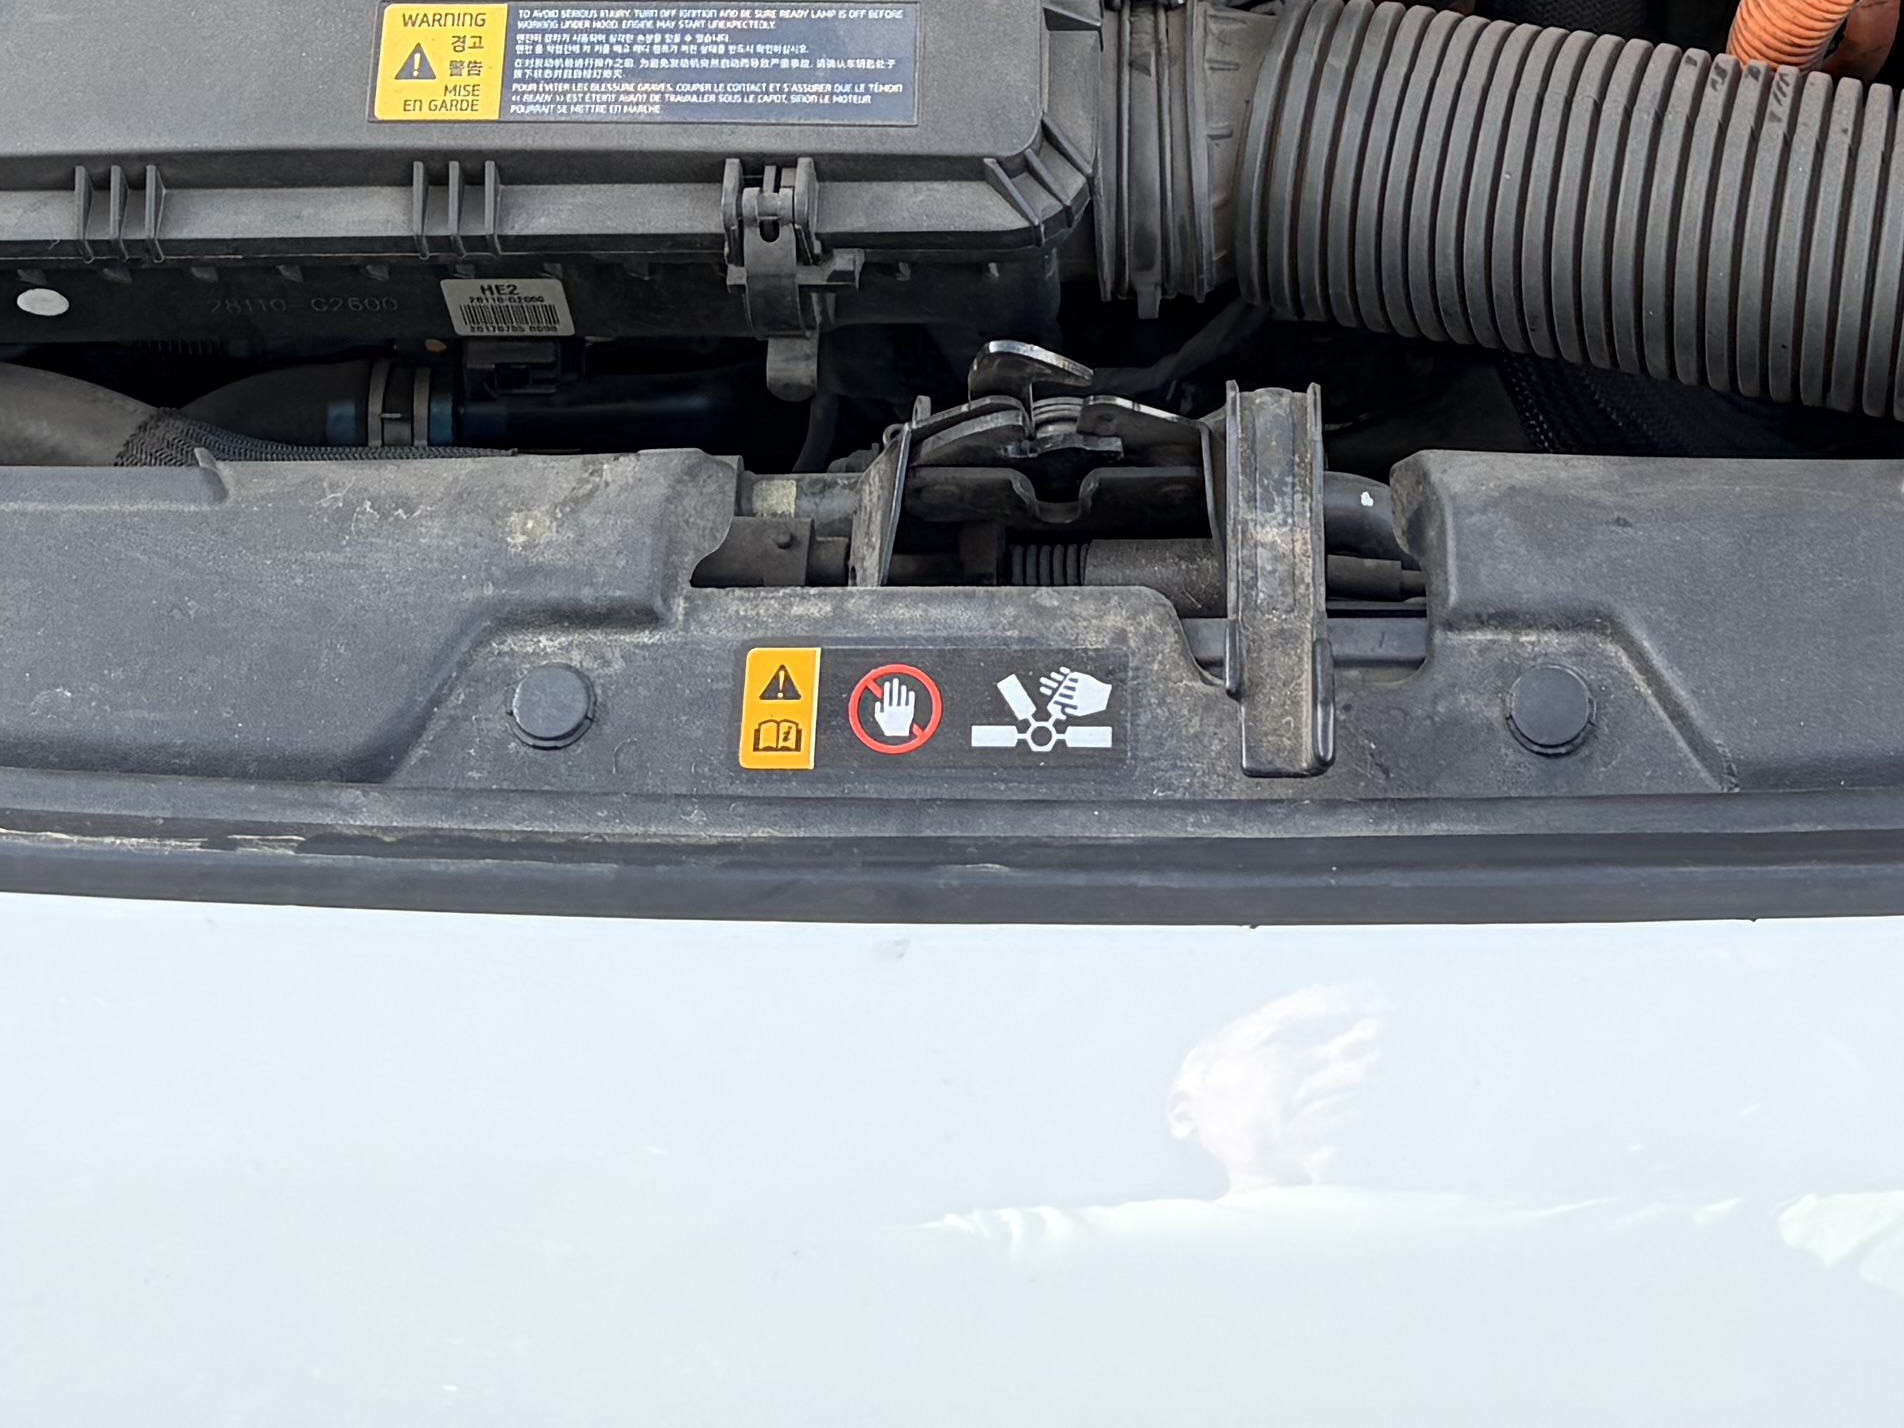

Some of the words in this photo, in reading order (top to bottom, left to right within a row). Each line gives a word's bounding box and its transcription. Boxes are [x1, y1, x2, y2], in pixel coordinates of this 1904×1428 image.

[519, 10, 530, 18] TO
[533, 10, 558, 18] AVOID
[561, 10, 597, 18] SERIOUS
[634, 10, 658, 18] TURN
[719, 10, 738, 18] AND
[741, 10, 752, 18] BE
[755, 10, 777, 18] SURE
[779, 10, 808, 18] READY
[811, 10, 836, 18] LAMP
[849, 10, 865, 18] OFF
[868, 10, 903, 18] BEFORE
[403, 13, 486, 27] WARNING
[517, 21, 558, 29] WORKING
[560, 21, 590, 29] UNDER
[622, 21, 654, 29] ENGINE
[656, 21, 676, 29] MAY
[679, 20, 705, 29] START
[452, 35, 484, 52] 경고
[449, 60, 483, 77] 警告
[444, 84, 480, 97] MISE
[512, 83, 537, 91] POUR
[714, 84, 724, 92] LE
[727, 83, 767, 92] CONTACT
[769, 83, 780, 92] ET
[834, 83, 852, 92] QUE
[854, 83, 865, 92] LE
[619, 94, 647, 102] AVANT
[649, 94, 661, 102] DE
[718, 94, 742, 103] SOUS
[744, 94, 755, 103] LE
[790, 94, 818, 104] SINON
[820, 94, 830, 104] LE
[832, 94, 872, 104] MOTEUR
[403, 99, 423, 112] EN
[428, 99, 480, 112] GARDE
[571, 105, 607, 114] METTRE
[480, 284, 519, 295] HE2
